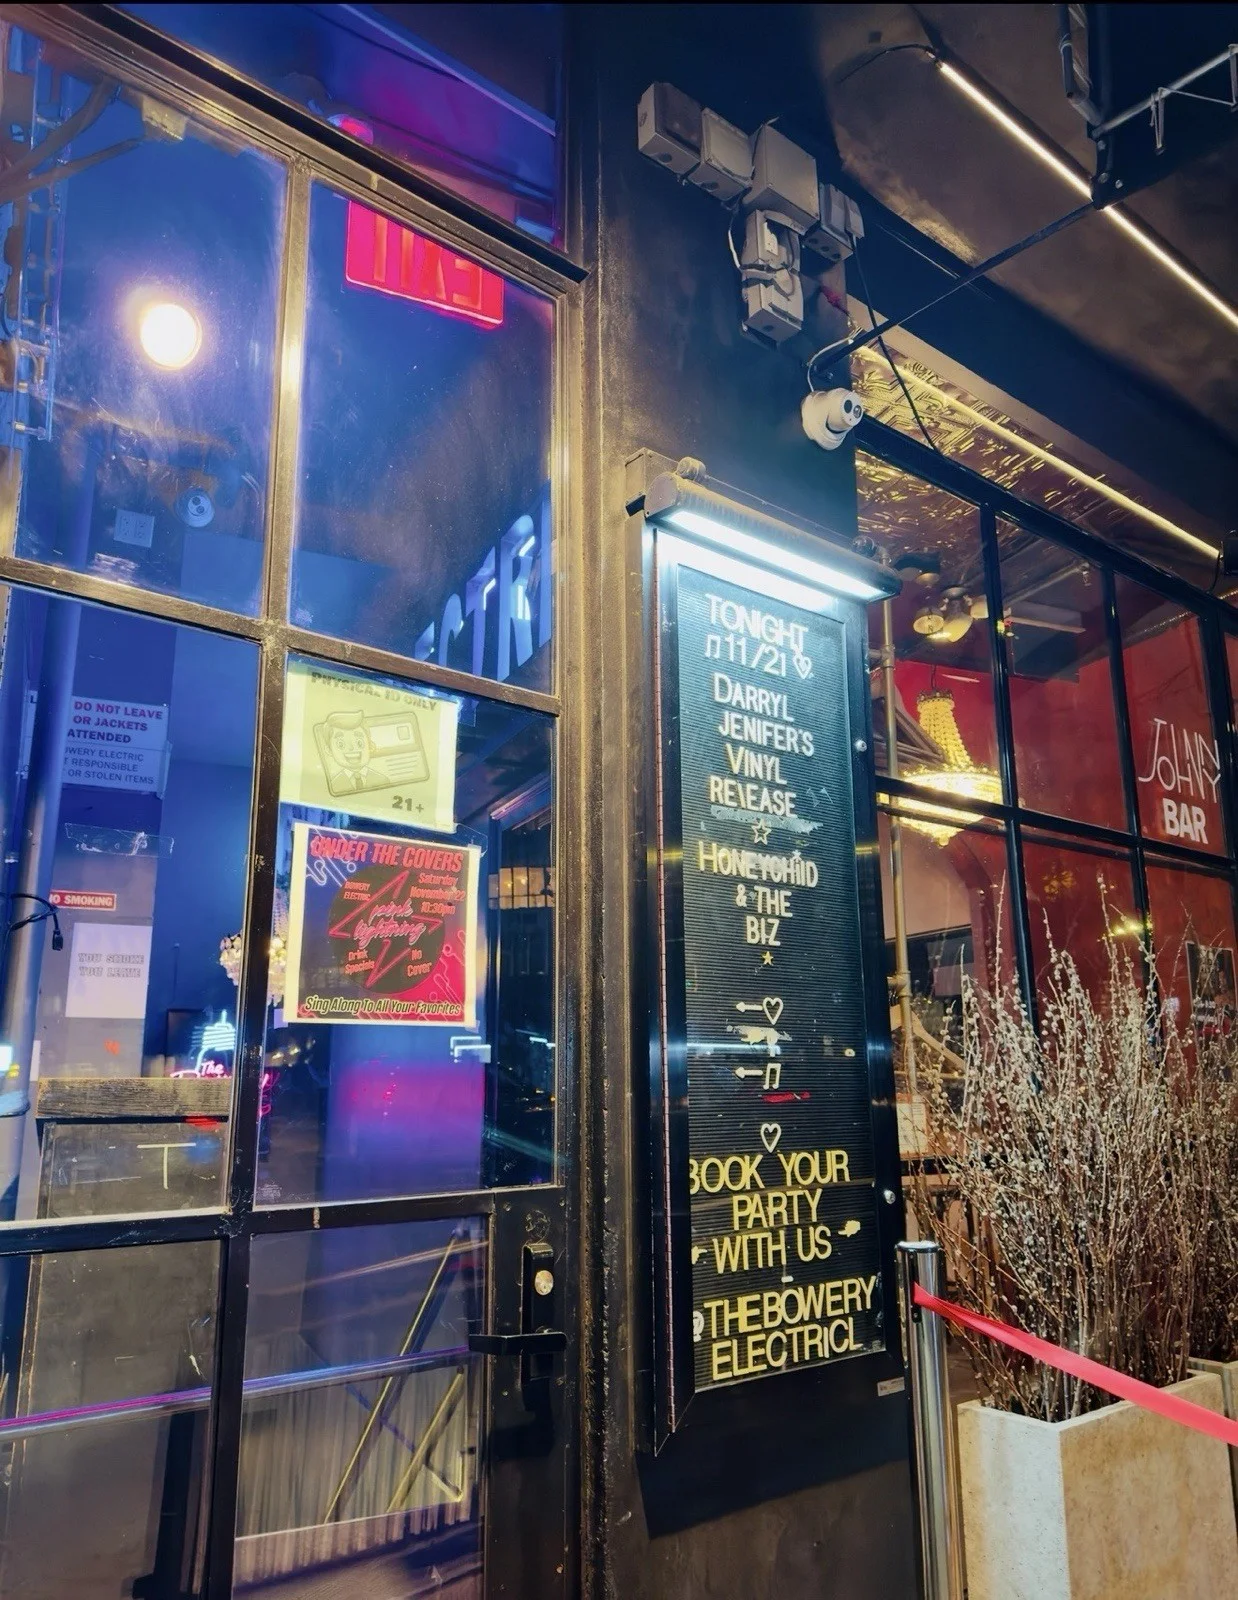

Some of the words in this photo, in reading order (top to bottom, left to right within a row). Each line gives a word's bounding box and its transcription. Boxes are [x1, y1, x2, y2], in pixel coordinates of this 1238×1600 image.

[705, 593, 808, 651] TONIGHT
[713, 672, 795, 722] DARRYL
[73, 715, 92, 726] OR
[94, 717, 148, 732] JACKETS
[74, 701, 93, 712] DO
[96, 703, 121, 715] NOT
[124, 707, 163, 720] LEAVE
[718, 711, 815, 757] JENIFER'S
[71, 757, 139, 773] RESPONSIBLE
[98, 749, 144, 762] ELECTRIC
[725, 743, 788, 785] VINYL
[67, 768, 82, 778] OR
[84, 770, 122, 782] STOLEN
[125, 775, 154, 785] ITEMS
[391, 795, 424, 813] 21+
[1162, 798, 1209, 844] BAR
[310, 836, 369, 862] UNDER
[371, 842, 402, 866] THE
[402, 847, 464, 873] COVERS
[418, 872, 458, 887] Saturday
[64, 894, 113, 907] SMOKING
[735, 884, 748, 908] &
[753, 885, 793, 917] THE
[746, 915, 781, 947] BIZ
[407, 962, 433, 977] Cover
[305, 995, 330, 1014] Sing
[330, 997, 362, 1015] Along
[362, 999, 374, 1012] To
[375, 999, 390, 1013] All
[390, 1000, 415, 1014] Your
[415, 1001, 462, 1015] Favorites
[201, 1060, 224, 1076] The
[777, 1150, 851, 1187] YOUR
[732, 1188, 823, 1230] PARTY
[712, 1229, 787, 1274] WITH
[797, 1226, 833, 1262] US
